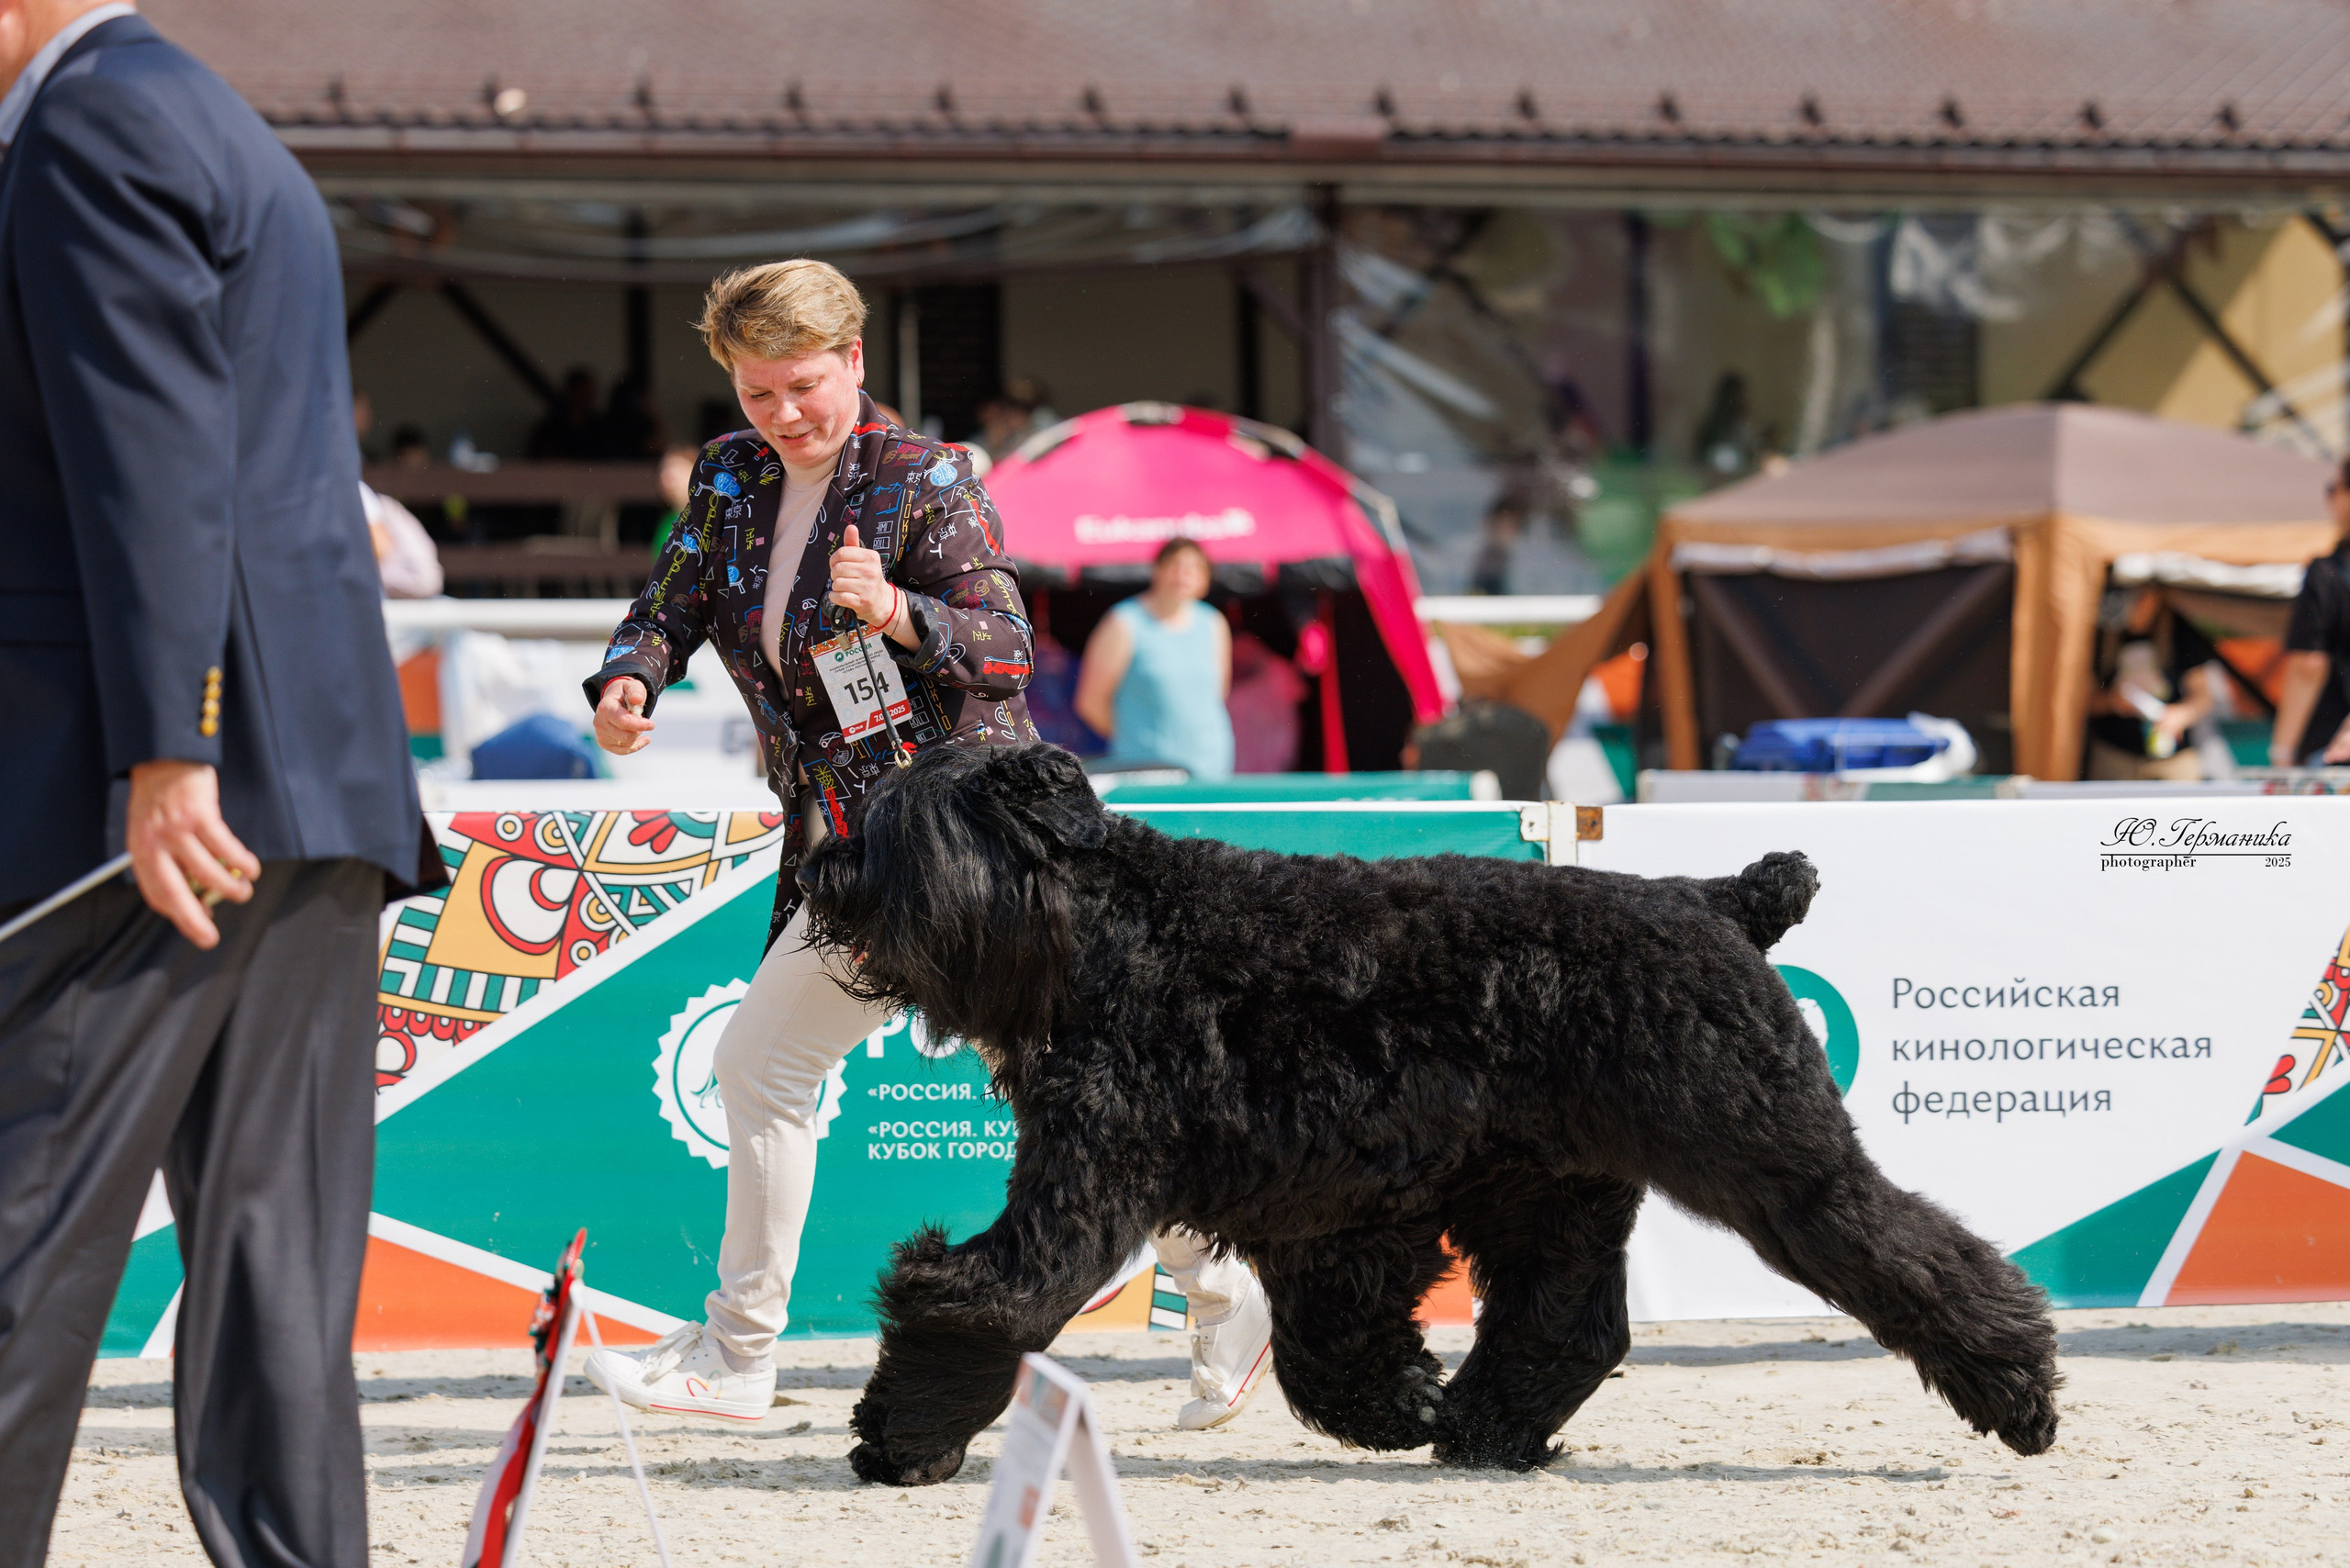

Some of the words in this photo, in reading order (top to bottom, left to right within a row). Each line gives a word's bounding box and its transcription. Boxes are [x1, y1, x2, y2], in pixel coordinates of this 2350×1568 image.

[699, 493, 720, 554] OPEN
[724, 504, 743, 520] 東京
[897, 490, 915, 562] TOKYO
[844, 671, 890, 705] 154
[924, 677, 952, 732] OKYO
[1893, 977, 2120, 1010] Российская
[1893, 1036, 2211, 1061] кинологическая
[867, 1082, 978, 1101] «РОССИЯ.
[1892, 1081, 2111, 1125] федерация
[867, 1120, 978, 1138] «РОССИЯ.
[868, 1142, 942, 1160] КУБОК
